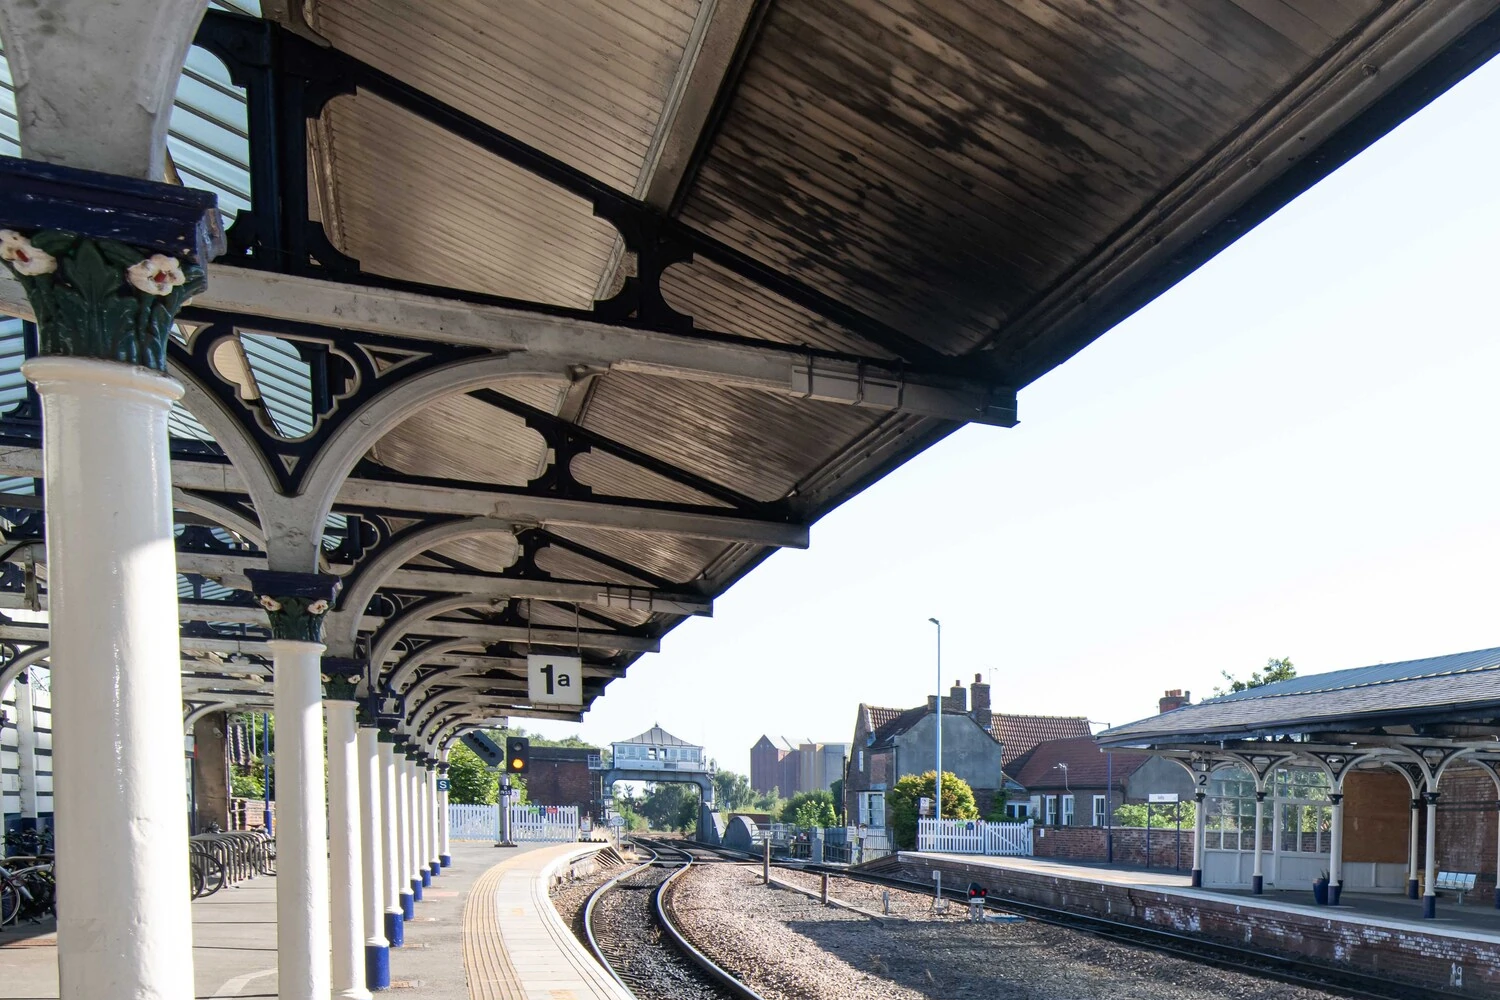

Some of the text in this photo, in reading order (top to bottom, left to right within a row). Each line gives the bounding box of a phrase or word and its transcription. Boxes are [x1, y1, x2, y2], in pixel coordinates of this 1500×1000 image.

[540, 664, 570, 695] 1a
[439, 781, 447, 789] S
[1199, 774, 1207, 786] 2
